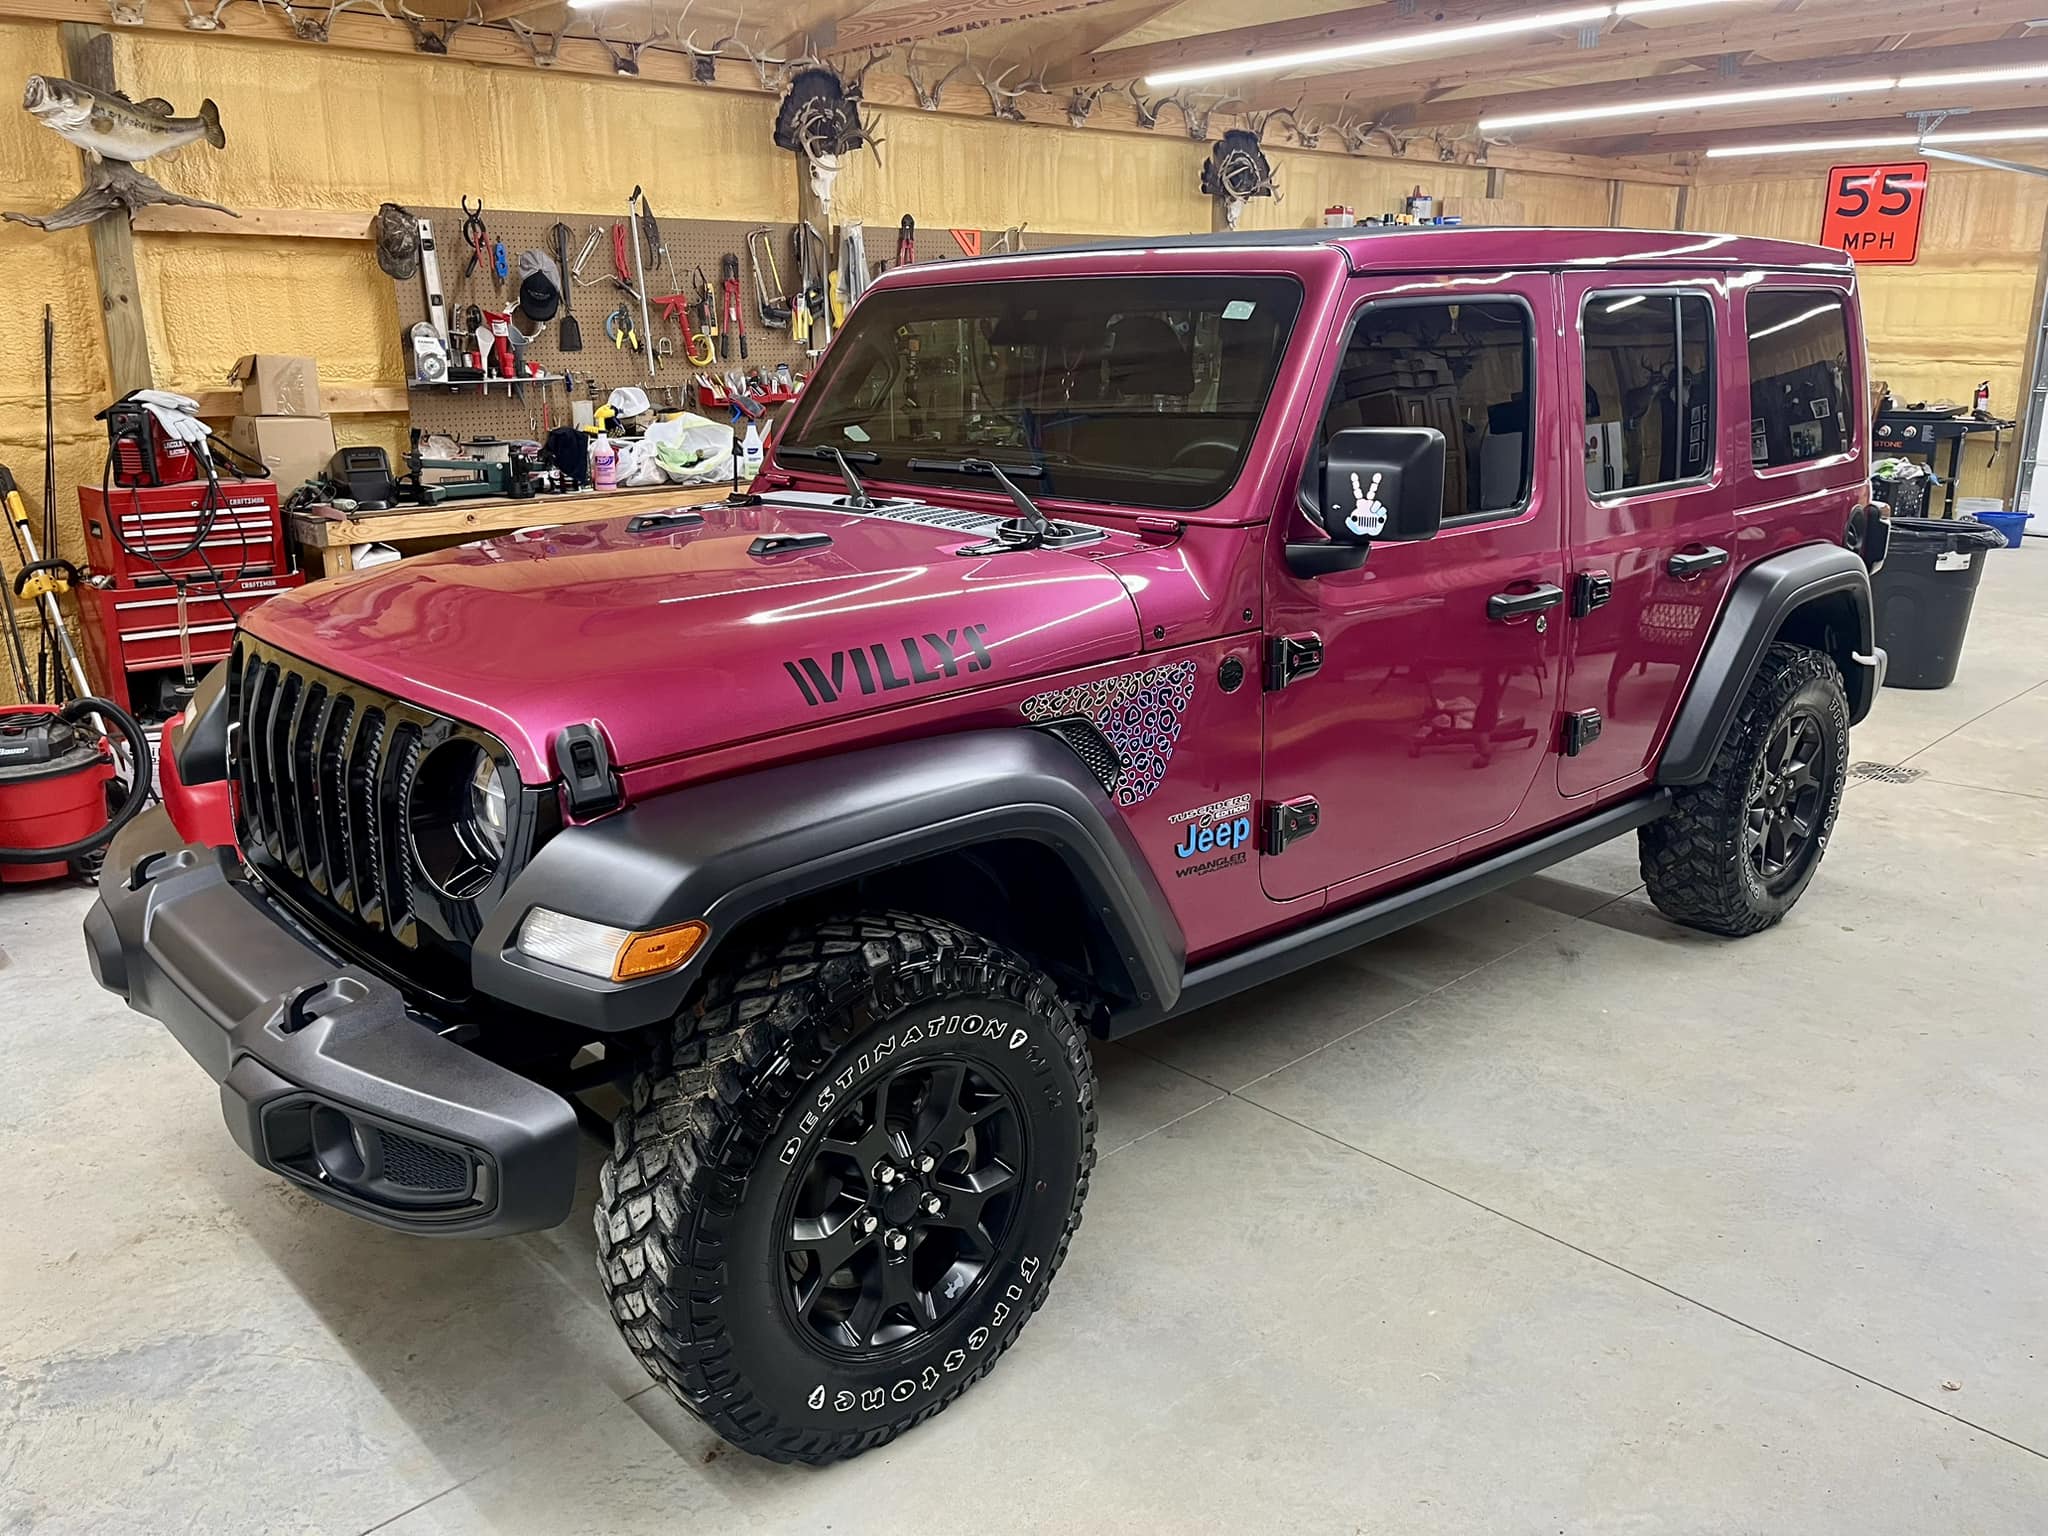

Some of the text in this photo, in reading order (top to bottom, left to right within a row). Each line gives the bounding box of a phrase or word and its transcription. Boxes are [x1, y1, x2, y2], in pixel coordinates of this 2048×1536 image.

[1835, 173, 1912, 217] 55
[1843, 232, 1894, 250] MPH
[229, 497, 265, 506] CRAFTSMAN
[241, 580, 276, 589] CRAFTSMAN
[783, 624, 992, 706] WILLYS
[1175, 816, 1250, 858] Jeep
[1176, 852, 1246, 878] WRANGLER
[780, 1015, 1007, 1165] DESTINATION
[834, 1256, 1040, 1411] Firestone
